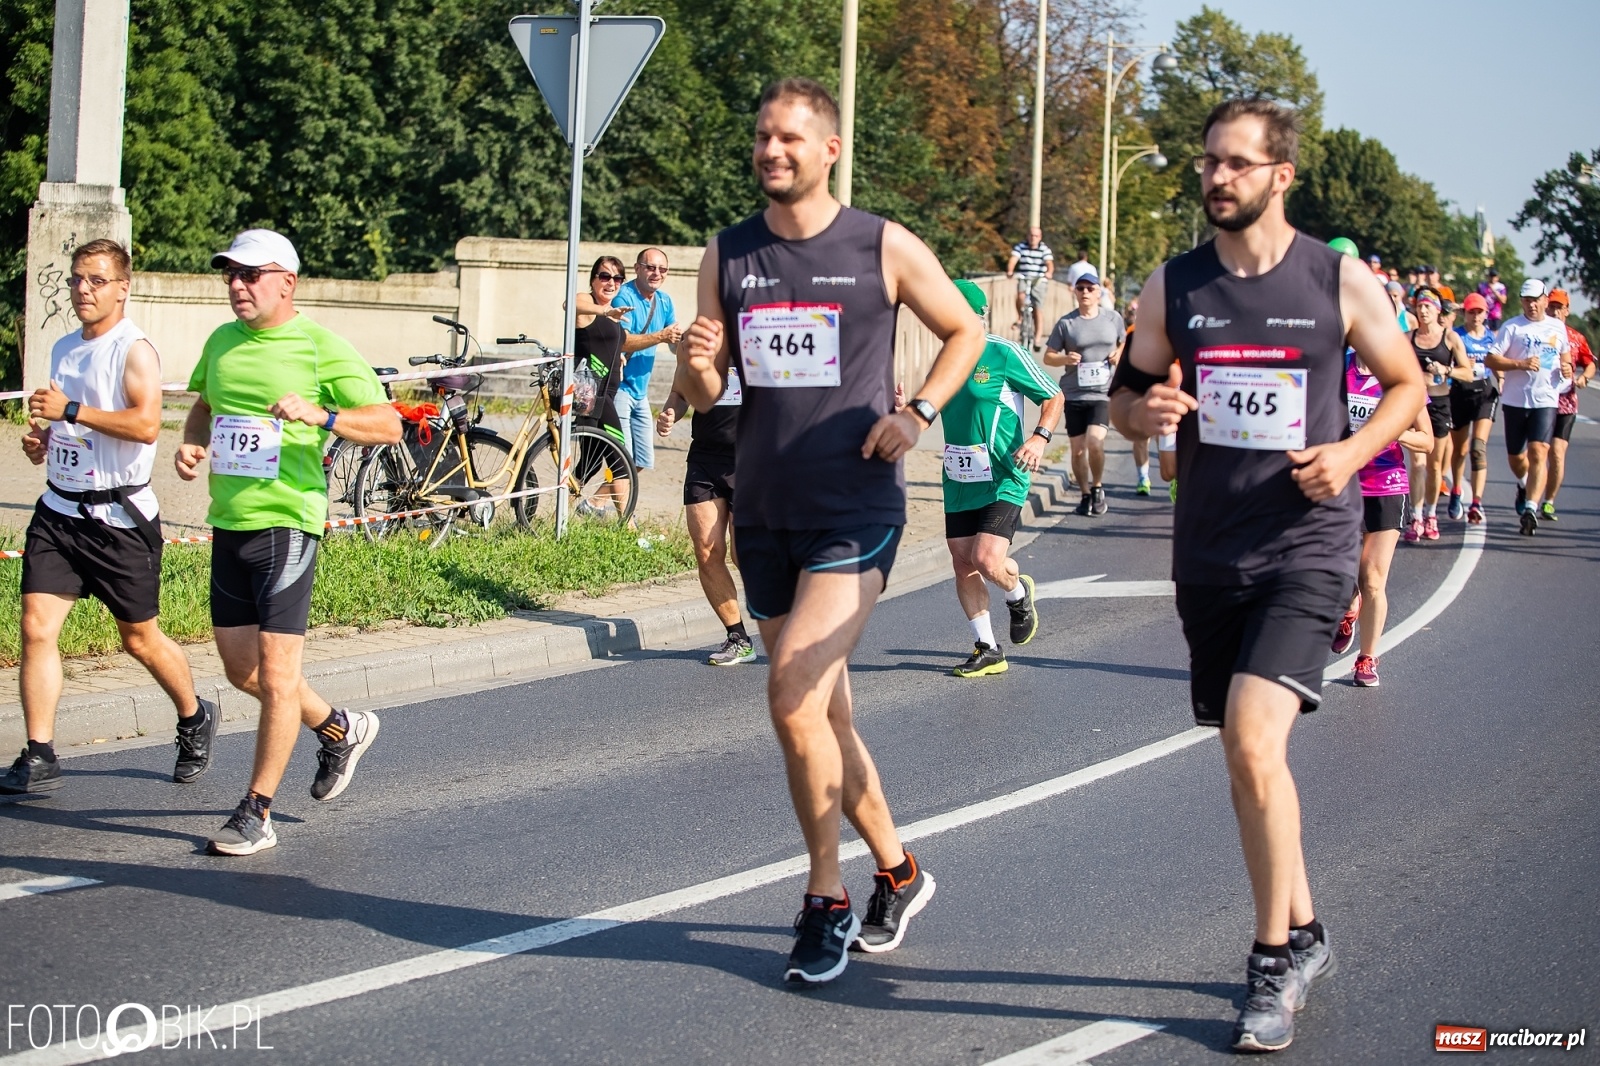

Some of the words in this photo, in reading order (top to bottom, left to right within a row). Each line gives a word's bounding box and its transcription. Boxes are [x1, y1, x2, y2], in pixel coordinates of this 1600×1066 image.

[769, 332, 816, 356] 464
[1090, 368, 1100, 376] 35
[1228, 391, 1277, 416] 465
[230, 432, 260, 453] 193
[56, 446, 79, 467] 173
[958, 456, 972, 468] 37
